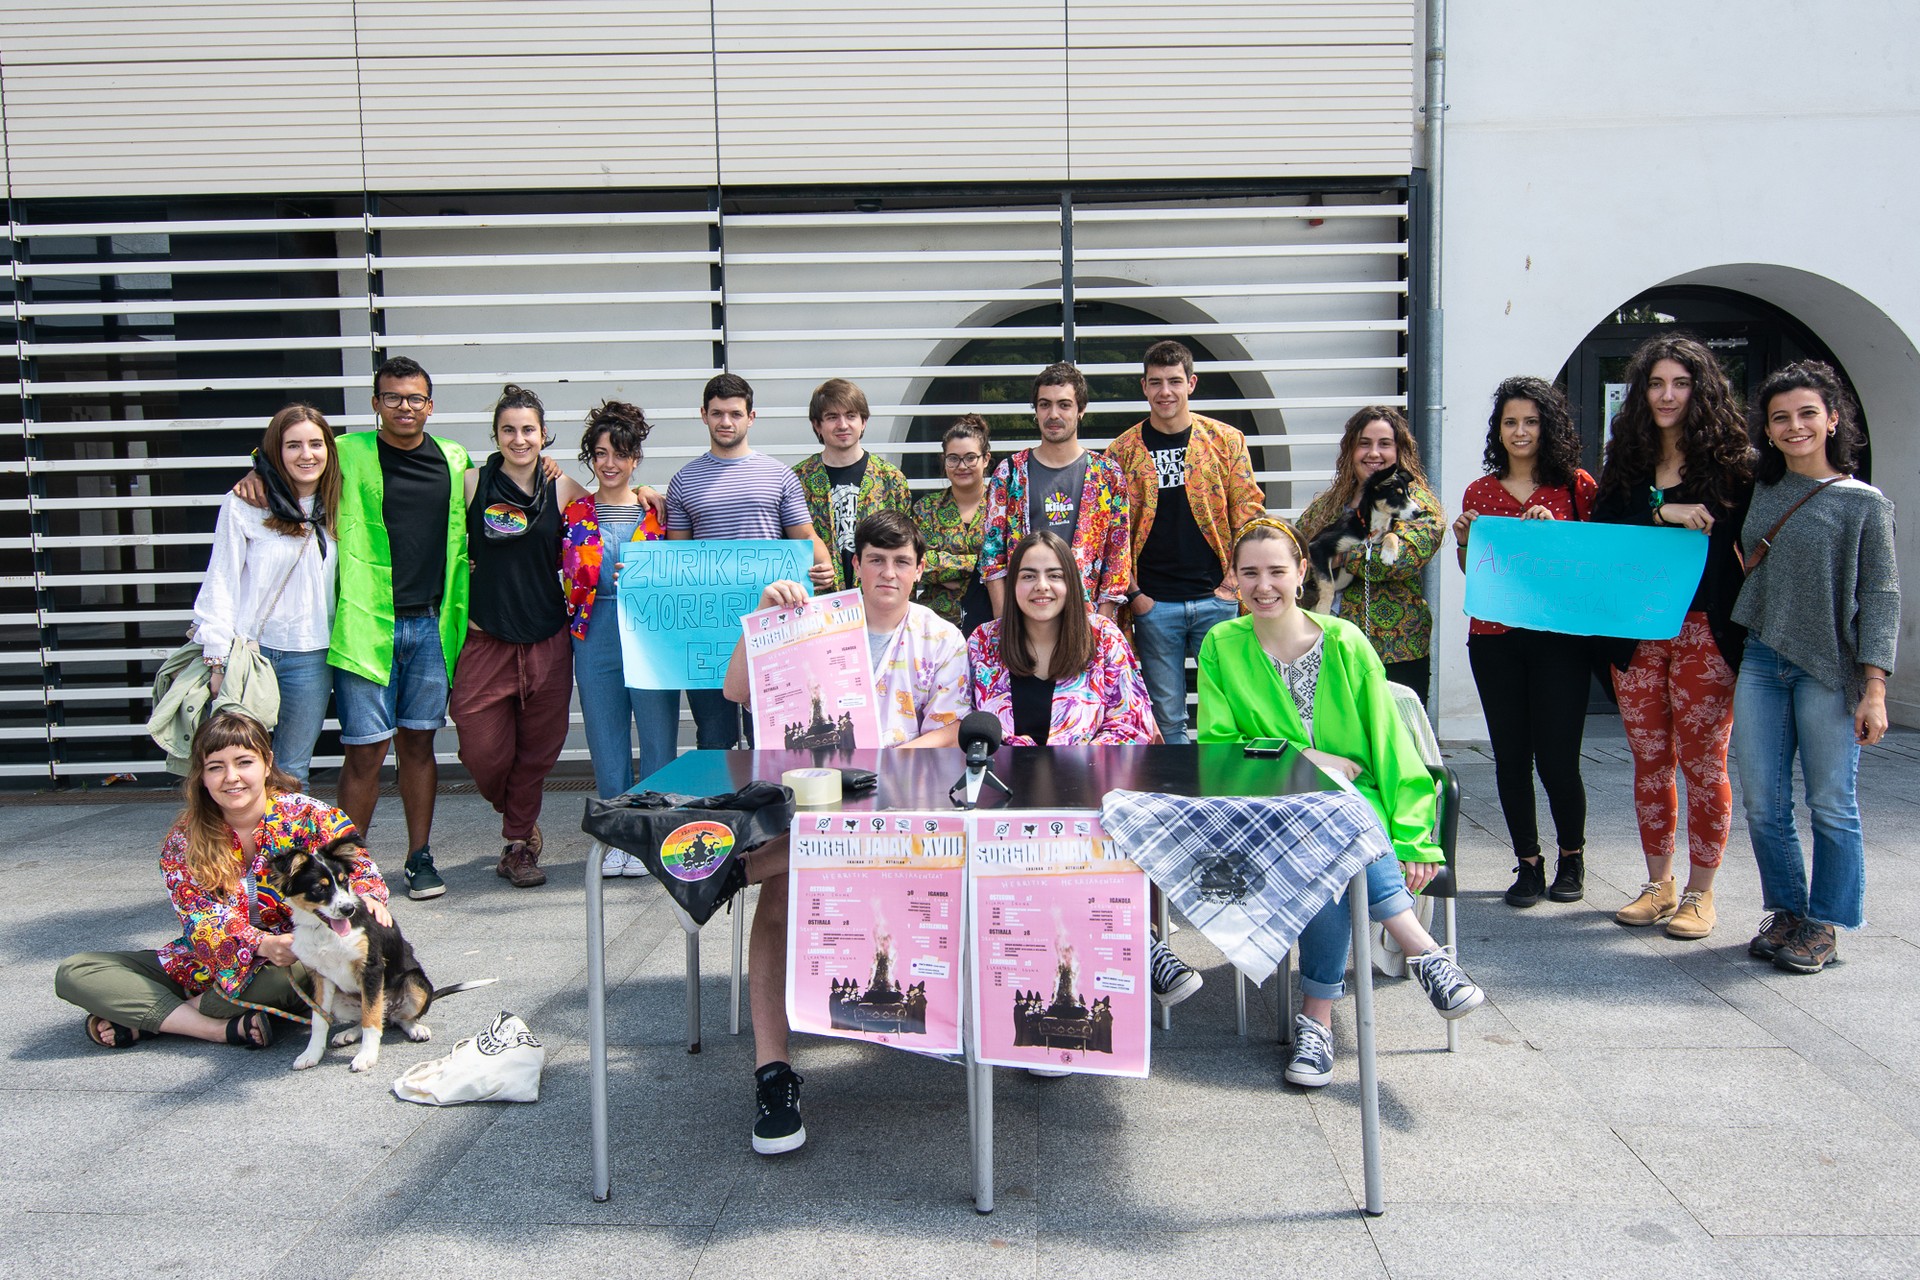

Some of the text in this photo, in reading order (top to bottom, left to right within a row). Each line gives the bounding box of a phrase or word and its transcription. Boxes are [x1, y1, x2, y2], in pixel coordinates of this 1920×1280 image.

[626, 585, 760, 632] MORERI
[796, 836, 862, 858] SORGIN
[864, 836, 913, 858] JAIAK
[976, 843, 1040, 864] SORGIN
[1043, 841, 1092, 863] JAIAK
